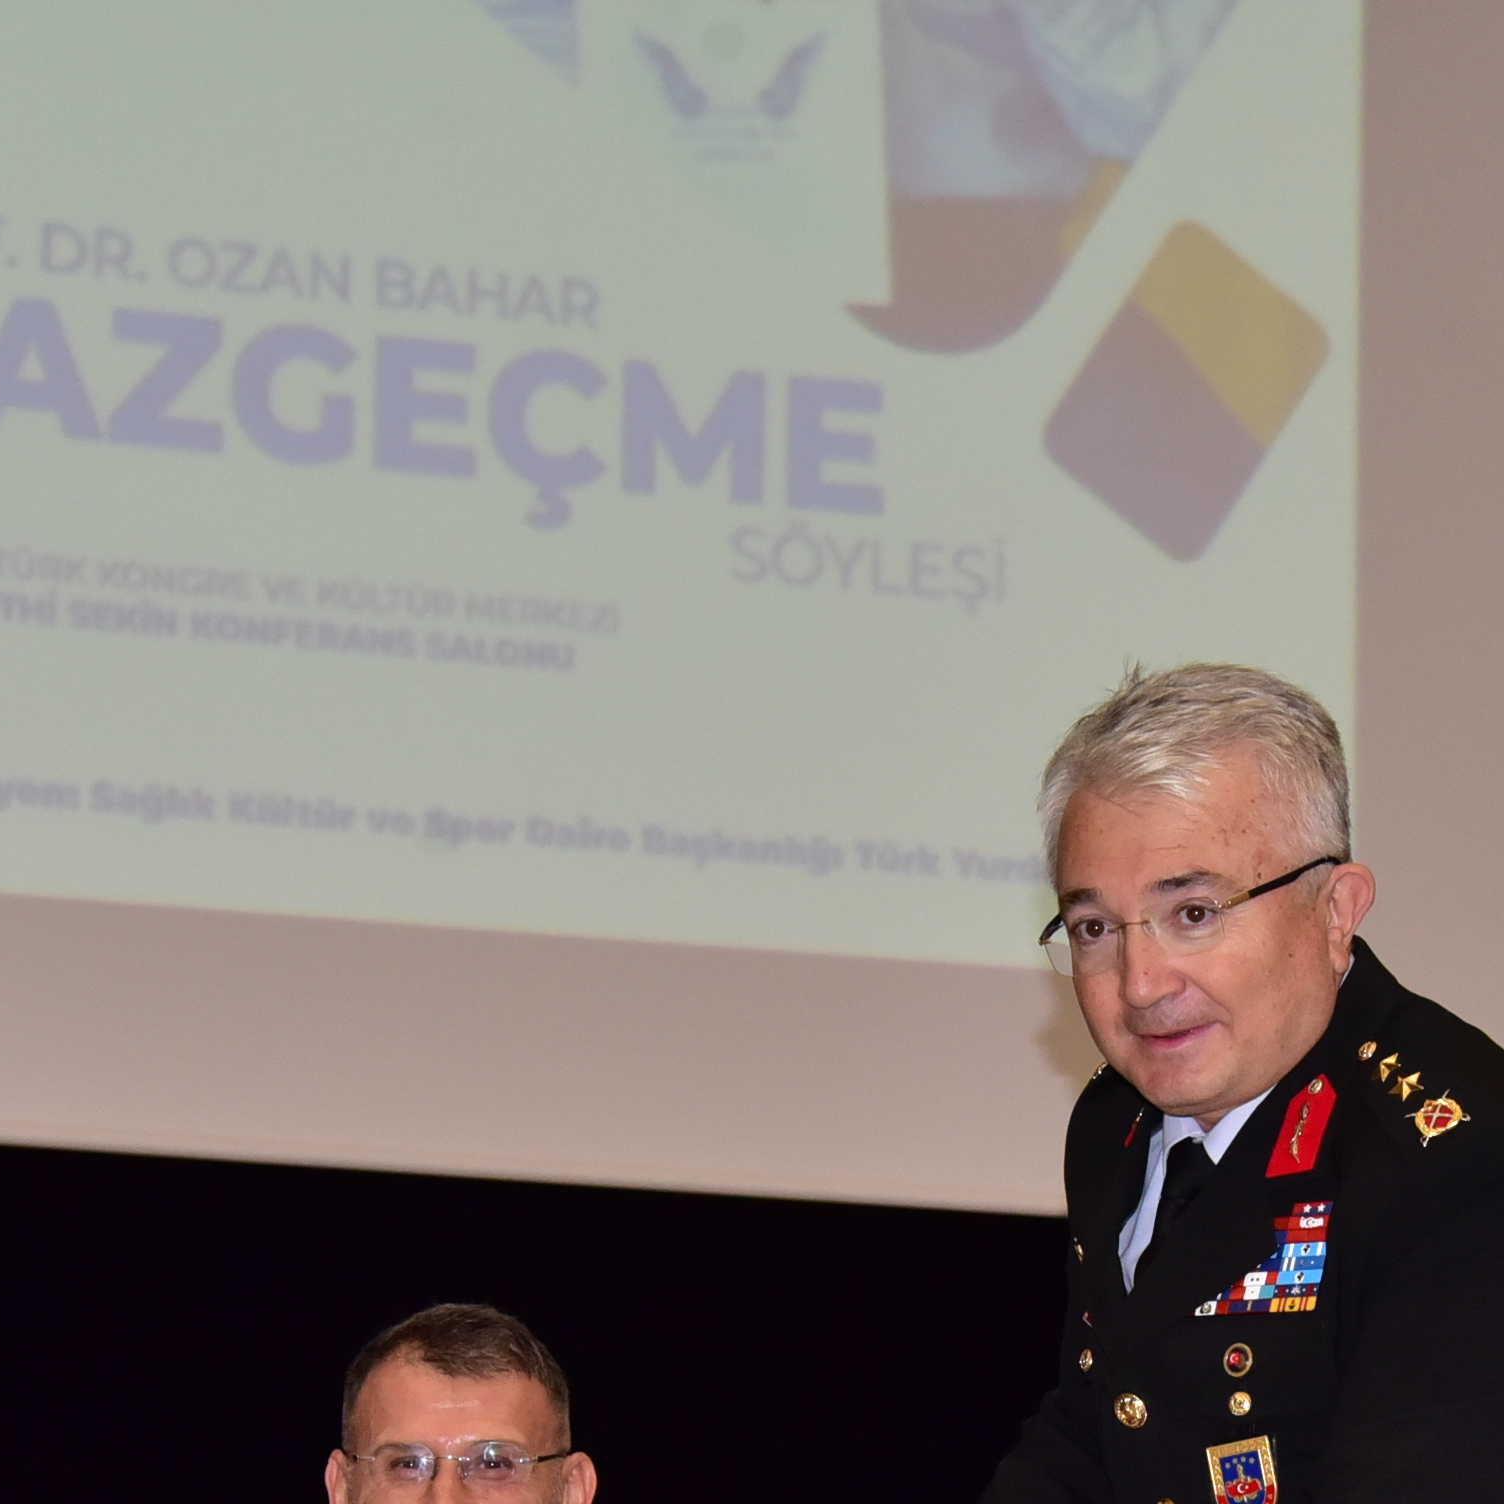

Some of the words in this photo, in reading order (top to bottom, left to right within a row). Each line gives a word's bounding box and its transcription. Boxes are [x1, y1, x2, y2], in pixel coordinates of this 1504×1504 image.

[39, 219, 149, 285] DR.
[167, 234, 353, 304] OZAN
[374, 256, 601, 329] BAHAR
[96, 557, 252, 602] KONGRE
[261, 575, 305, 607] VE
[730, 518, 1008, 617] SÖYLEŞİ
[190, 609, 417, 658] KONFERANS
[228, 789, 356, 834] Kültür
[365, 807, 415, 837] ve
[423, 806, 516, 850] Spor
[526, 814, 632, 853] Daire
[854, 838, 940, 876] Türk
